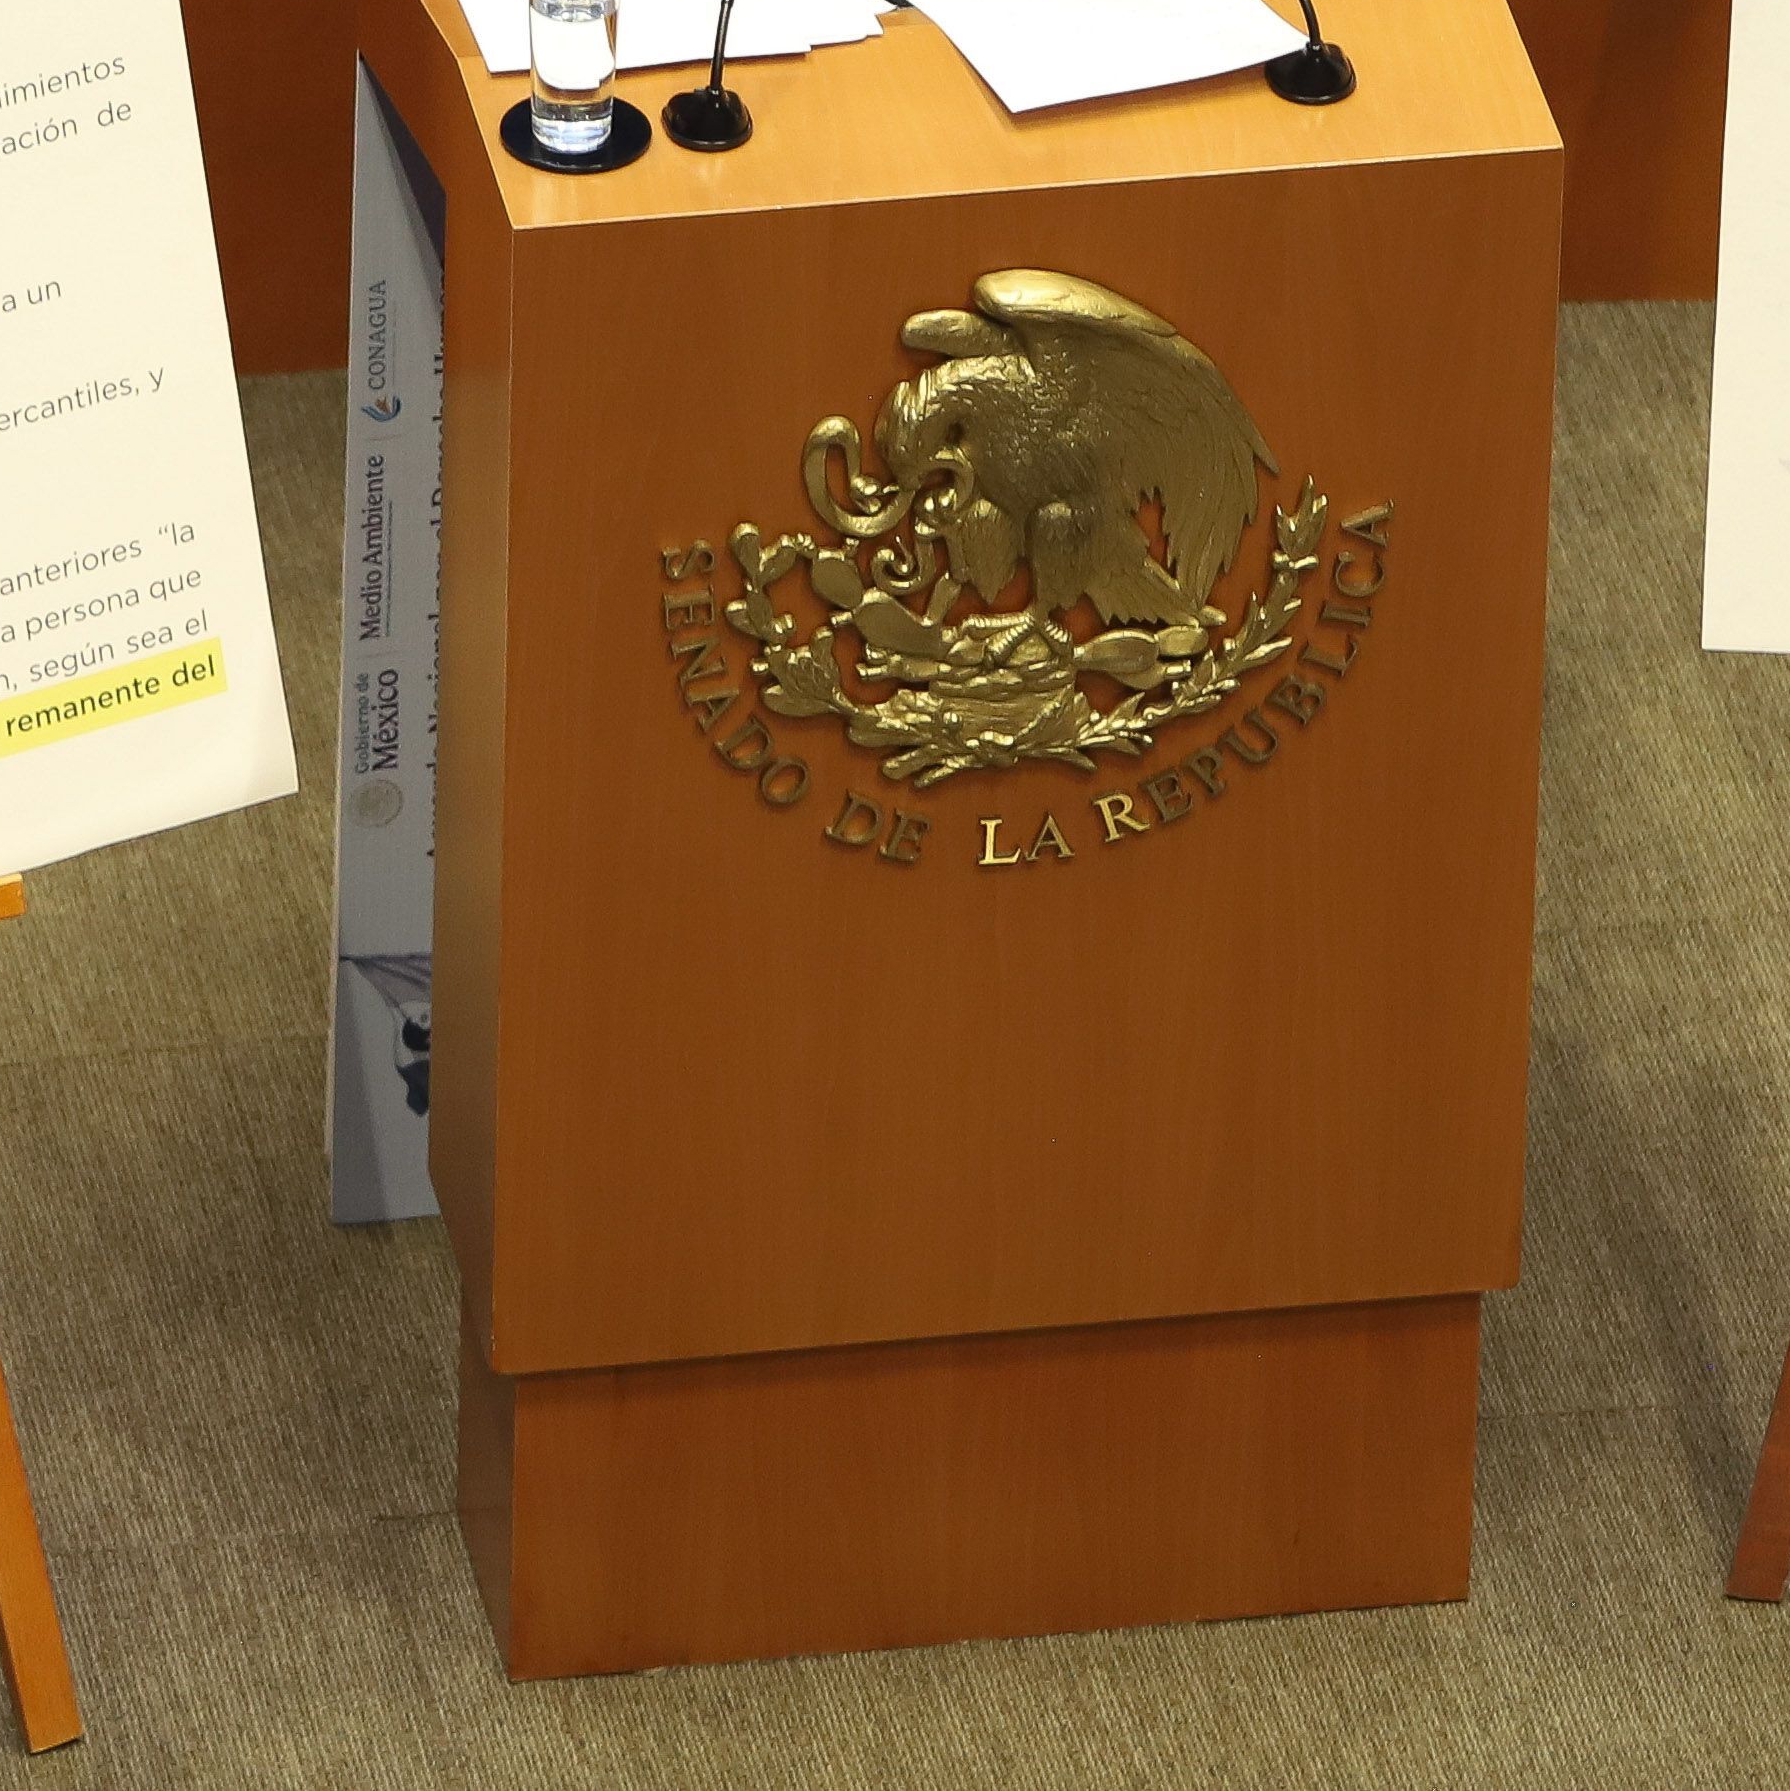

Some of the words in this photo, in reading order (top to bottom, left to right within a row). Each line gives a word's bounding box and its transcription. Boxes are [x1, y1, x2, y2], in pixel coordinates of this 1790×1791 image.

[97, 101, 131, 127] de
[368, 279, 387, 391] CONAGUA
[361, 455, 385, 567] Ambiente
[359, 570, 382, 641] Medio
[6, 676, 160, 737] remanente
[172, 654, 215, 687] del
[356, 674, 369, 695] de
[371, 668, 400, 771] México
[661, 539, 810, 805] SENADO
[824, 790, 930, 865] DE
[977, 813, 1074, 868] LA
[1092, 498, 1397, 844] REPUBLICA
[355, 698, 370, 775] Gobierno
